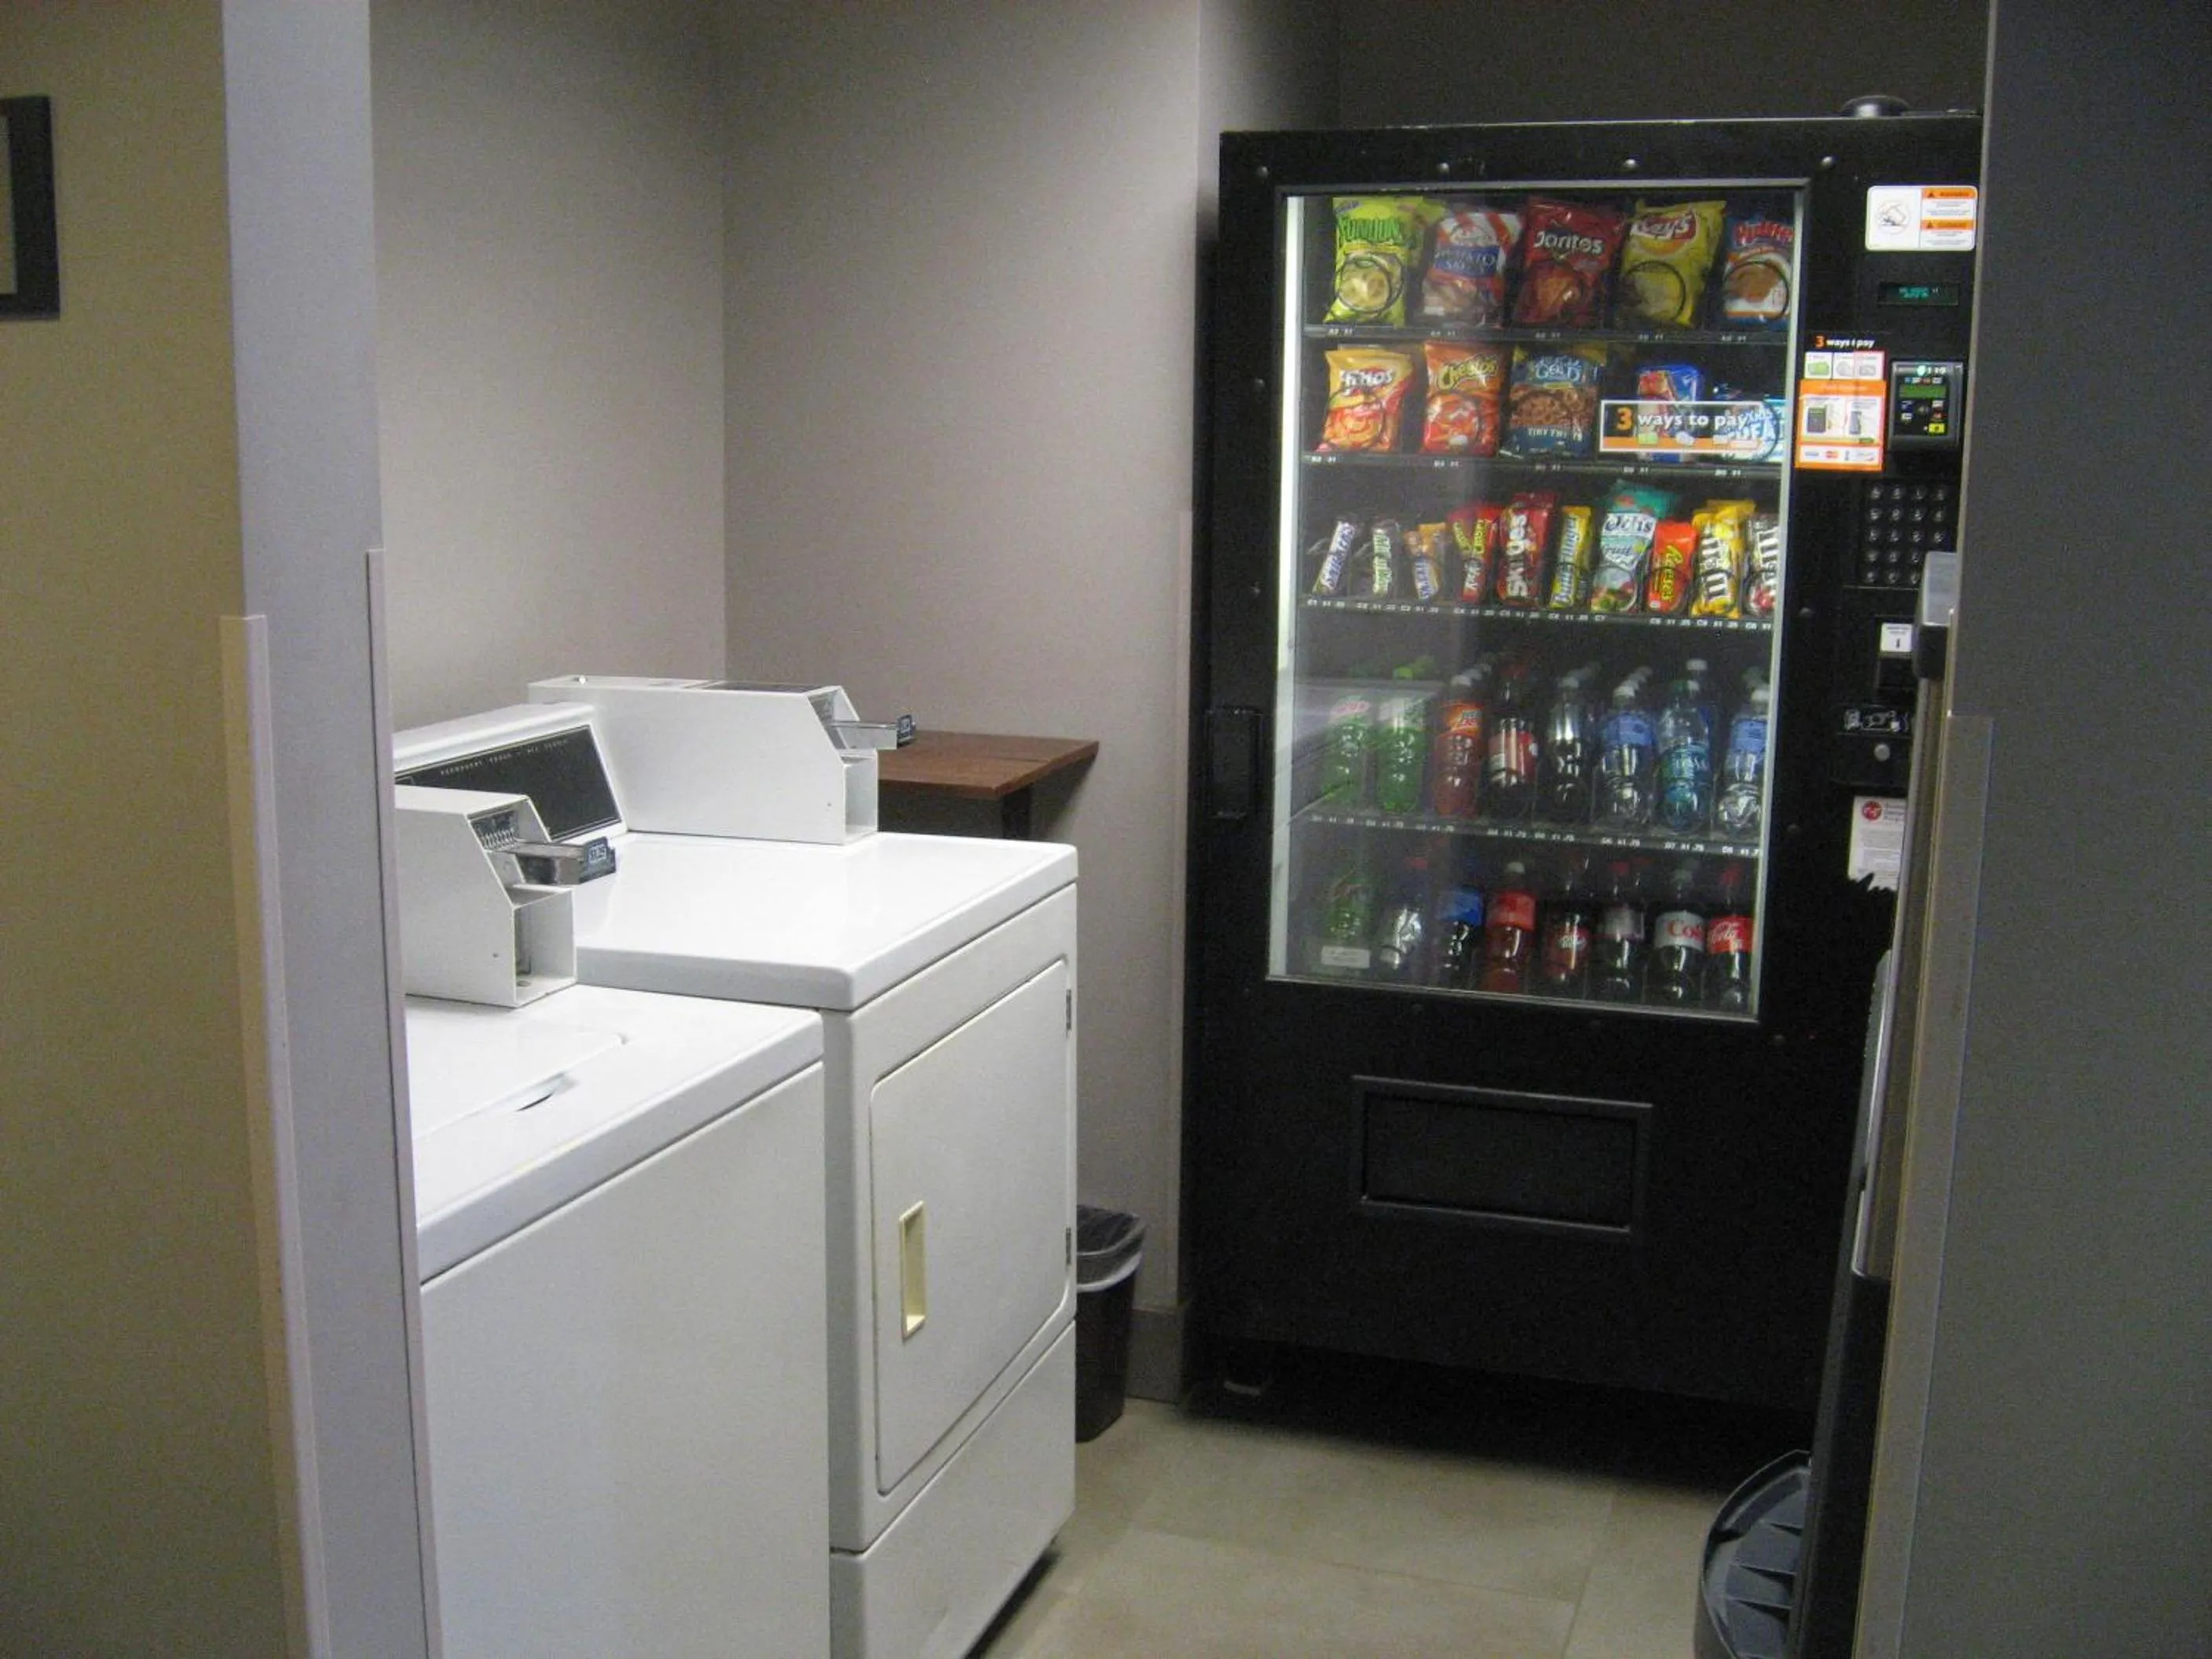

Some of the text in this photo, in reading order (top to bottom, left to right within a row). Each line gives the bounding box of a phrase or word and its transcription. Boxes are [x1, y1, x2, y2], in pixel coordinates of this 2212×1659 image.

[1815, 335, 1826, 348] 3
[1616, 407, 1633, 430] 3
[1637, 414, 1684, 429] ways
[1688, 412, 1709, 427] to
[1715, 414, 1749, 430] pay
